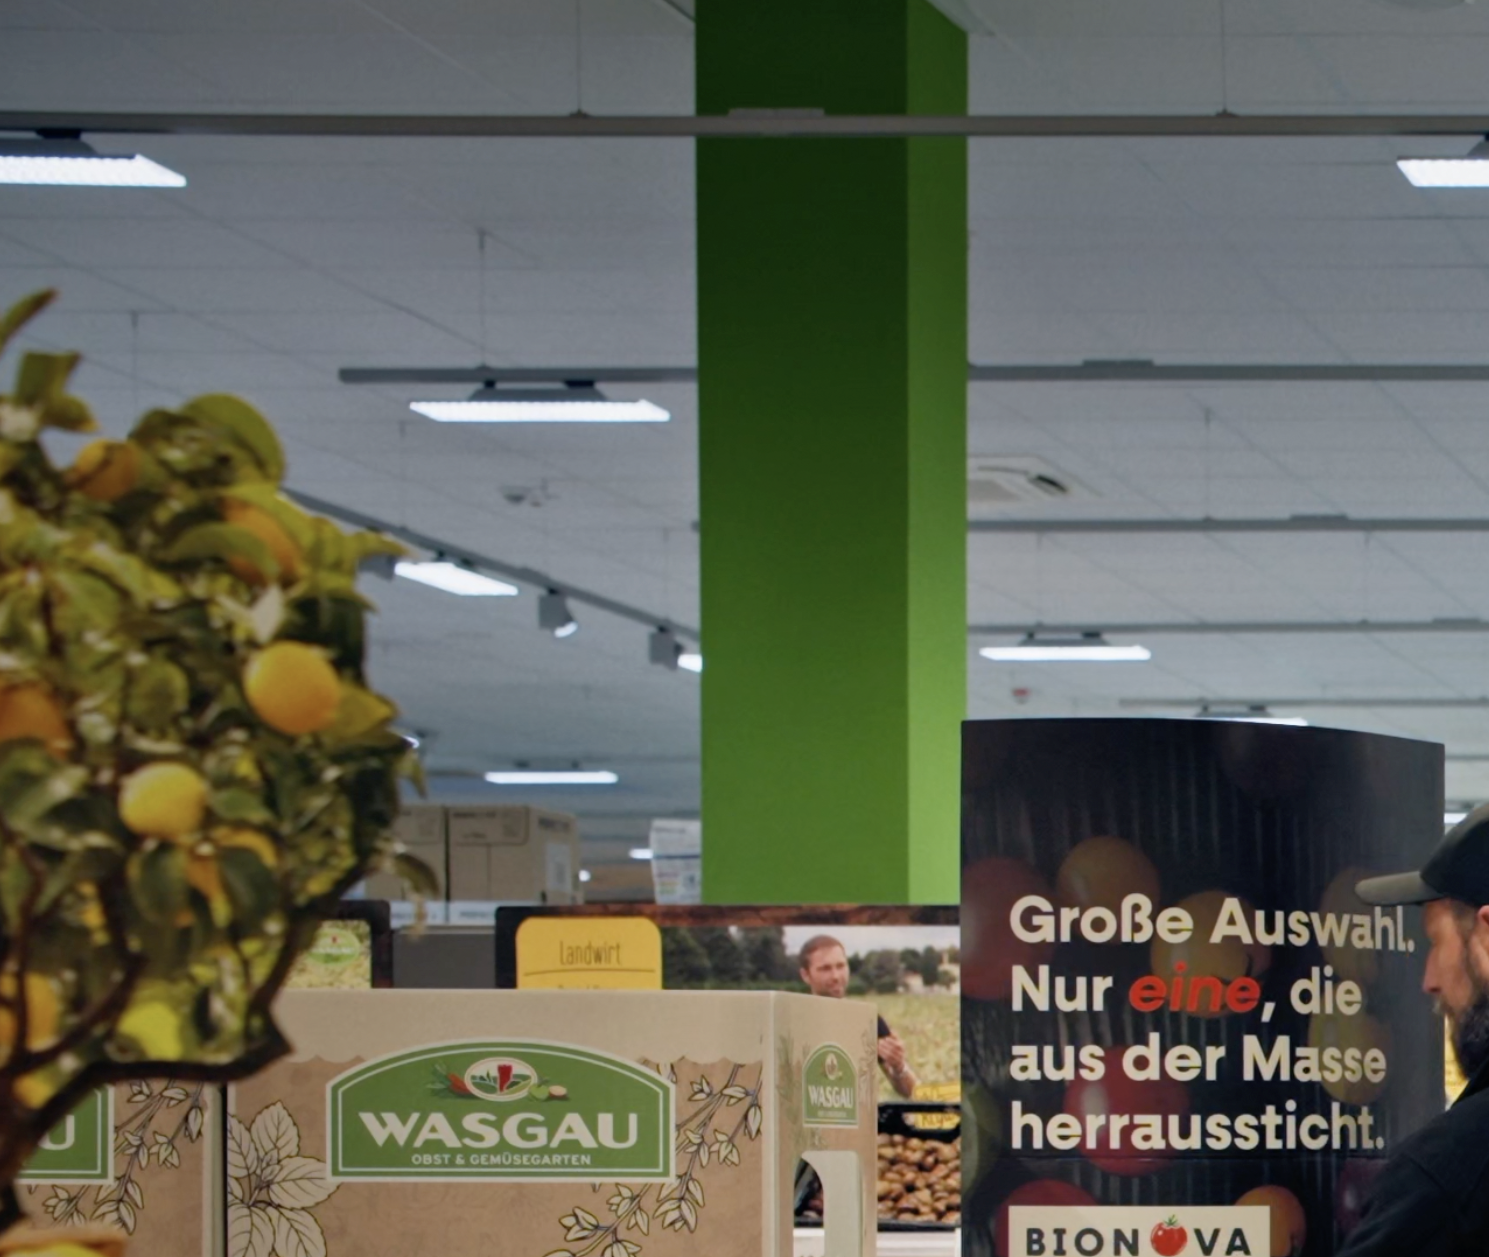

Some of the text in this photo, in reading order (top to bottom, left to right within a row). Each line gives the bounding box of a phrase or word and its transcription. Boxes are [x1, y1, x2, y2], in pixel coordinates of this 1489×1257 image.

[1009, 892, 1415, 953] Große Auswahl.
[559, 940, 621, 966] Landwirt
[1010, 961, 1362, 1022] Nur eine, die
[1009, 1032, 1387, 1084] aus der Masse
[807, 1085, 854, 1109] WASGAU
[358, 1111, 638, 1149] WASGAU
[1010, 1099, 1385, 1151] herraussticht.
[411, 1152, 592, 1166] OBST & GEMÜSEGARTEN
